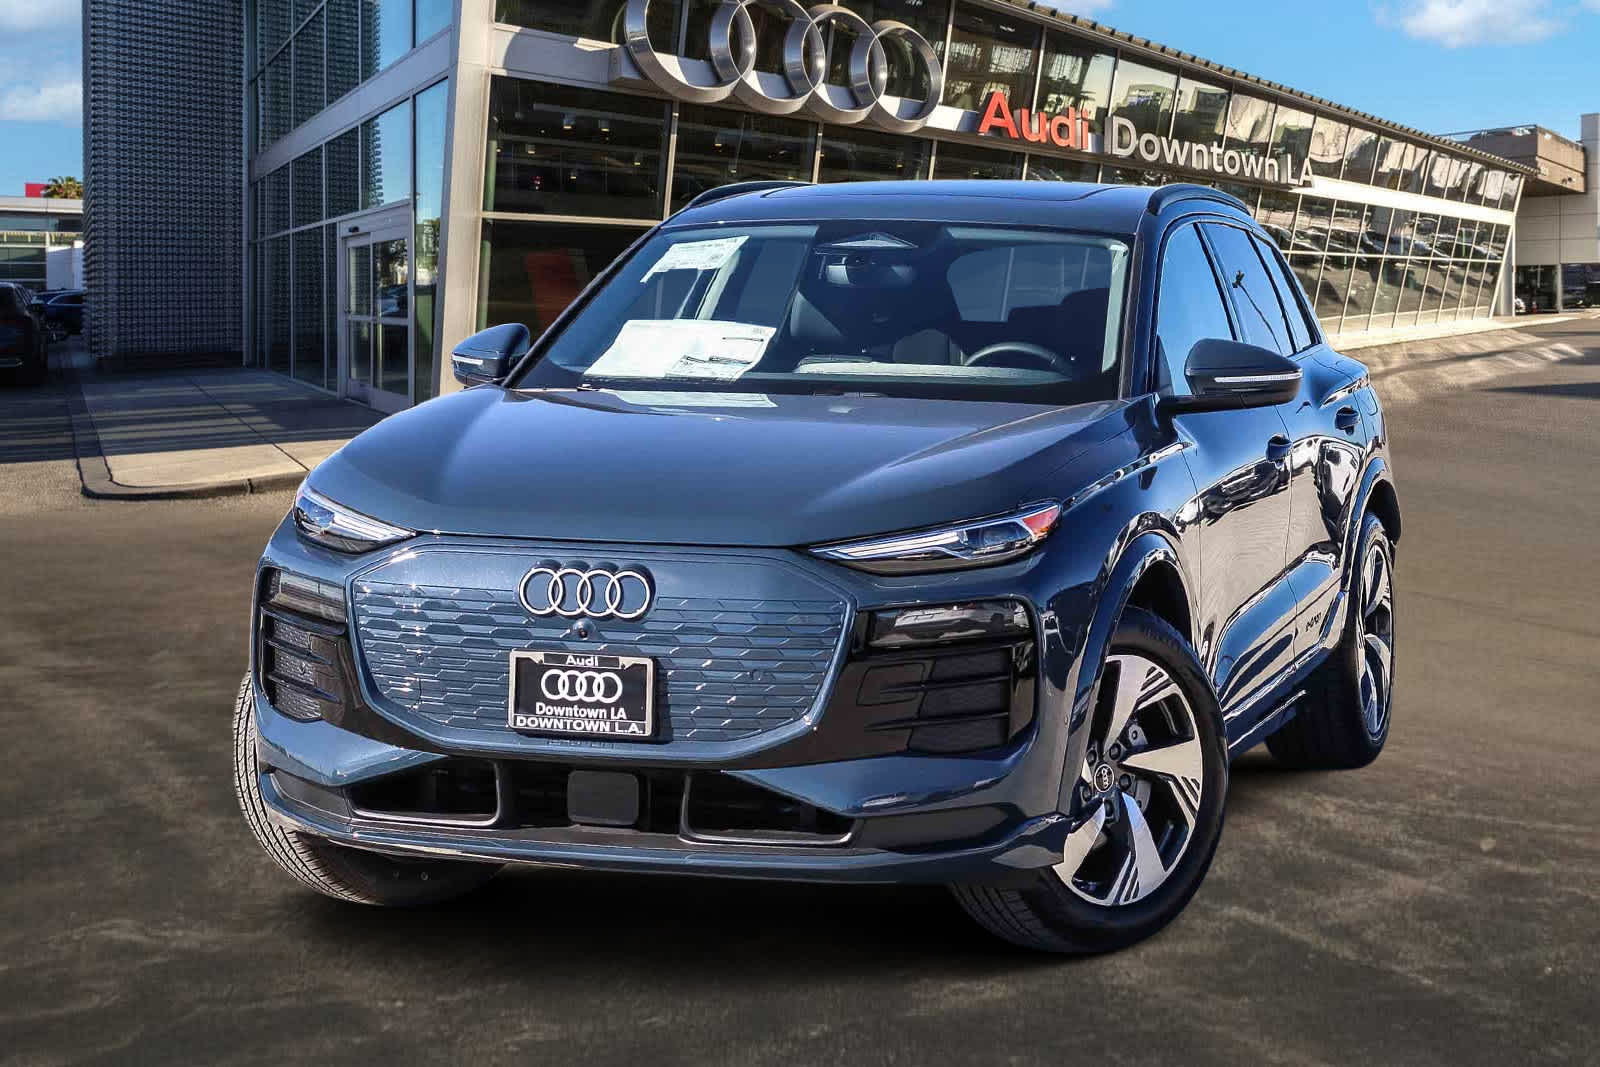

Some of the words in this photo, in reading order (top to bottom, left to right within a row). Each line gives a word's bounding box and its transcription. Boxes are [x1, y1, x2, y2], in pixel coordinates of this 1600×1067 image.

[978, 91, 1089, 150] Audi
[1107, 116, 1279, 182] Downtown
[1285, 155, 1315, 185] LA
[566, 655, 599, 667] Audi
[536, 702, 607, 719] Downtown
[611, 707, 627, 719] LA
[516, 716, 610, 732] DOWNTOWN
[615, 722, 644, 734] L.A.
